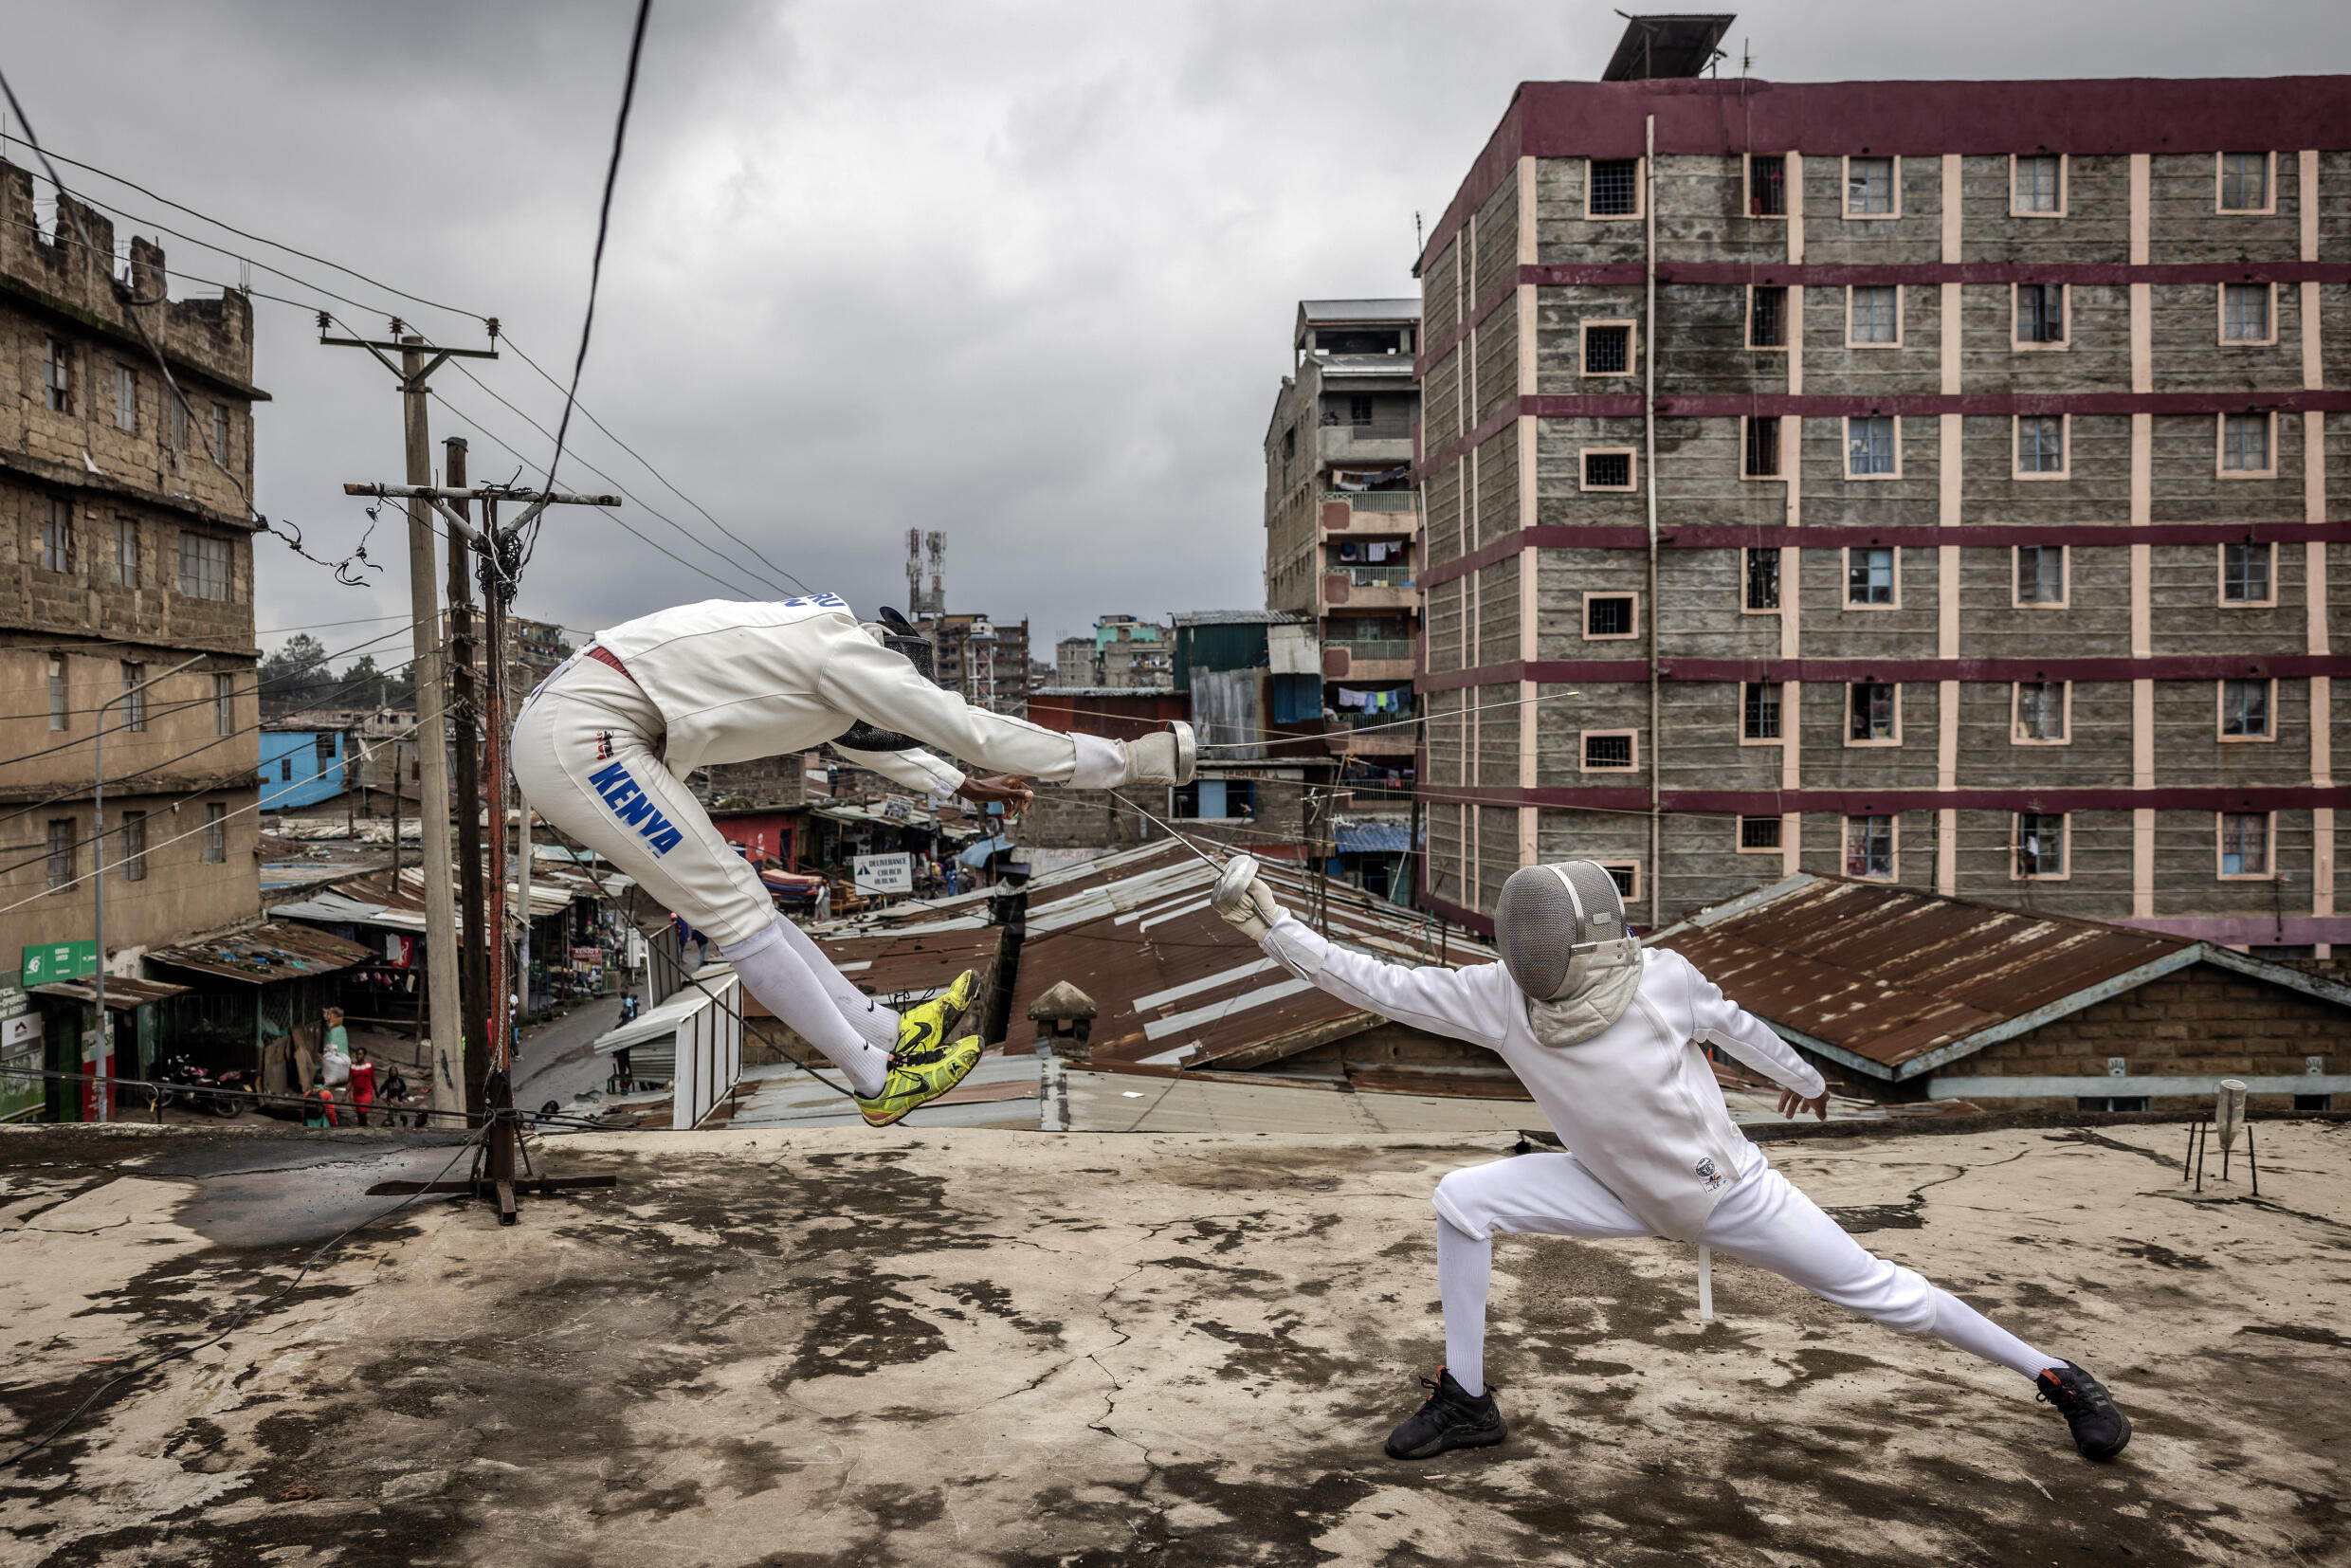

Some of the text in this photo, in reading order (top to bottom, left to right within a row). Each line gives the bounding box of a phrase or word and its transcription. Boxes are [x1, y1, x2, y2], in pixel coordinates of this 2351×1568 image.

[588, 761, 683, 859] KENYA
[868, 857, 906, 867] DELIVERANCE
[877, 867, 902, 877] CHURCH
